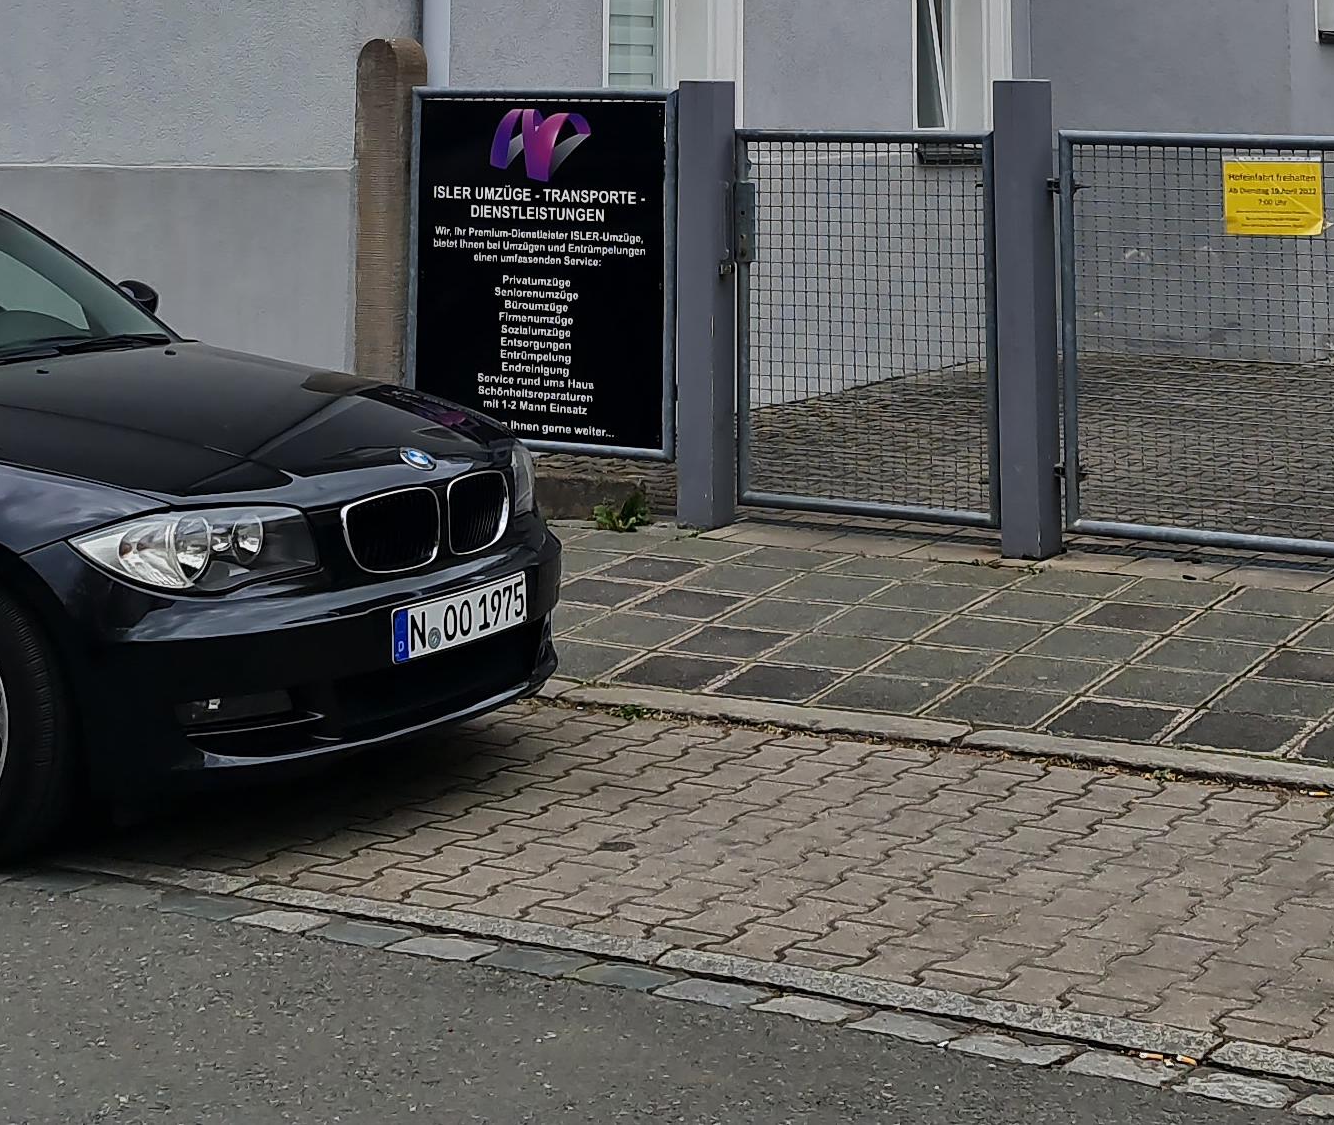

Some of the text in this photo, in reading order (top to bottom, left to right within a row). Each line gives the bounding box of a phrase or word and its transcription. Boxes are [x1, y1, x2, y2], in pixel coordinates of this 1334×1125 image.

[434, 186, 471, 200] ISLER
[476, 185, 532, 201] UMZÜGE
[543, 189, 637, 205] TRANSPORTE
[471, 205, 605, 222] DIENSTLEISTUNGEN
[435, 226, 452, 236] Wir,
[454, 226, 466, 236] Ihr
[469, 228, 568, 240] Premium-Dienstleister
[433, 238, 646, 257] bietet Ihnen bei Umzügen und Entrümpelungen
[474, 253, 602, 267] einen umfassenden Service:
[503, 275, 571, 289] Privatumzüge
[495, 287, 579, 302] Seniorenumzüge
[505, 300, 568, 314] Büroumzüge
[499, 312, 573, 326] Firmenumzüge
[501, 325, 571, 339] Sozialumzüge
[501, 337, 571, 351] Entsorgungen
[500, 349, 571, 365] Entrümpelung
[502, 362, 570, 377] Endreinigung
[478, 373, 594, 390] Service rund ums Haus
[478, 386, 593, 403] Schönheitsreparaturen
[483, 399, 588, 415] mit 1-2 Mann Einsatz
[511, 420, 539, 432] Ihnen
[542, 423, 571, 434] gerne
[410, 612, 427, 652] N
[478, 581, 525, 632] 1975
